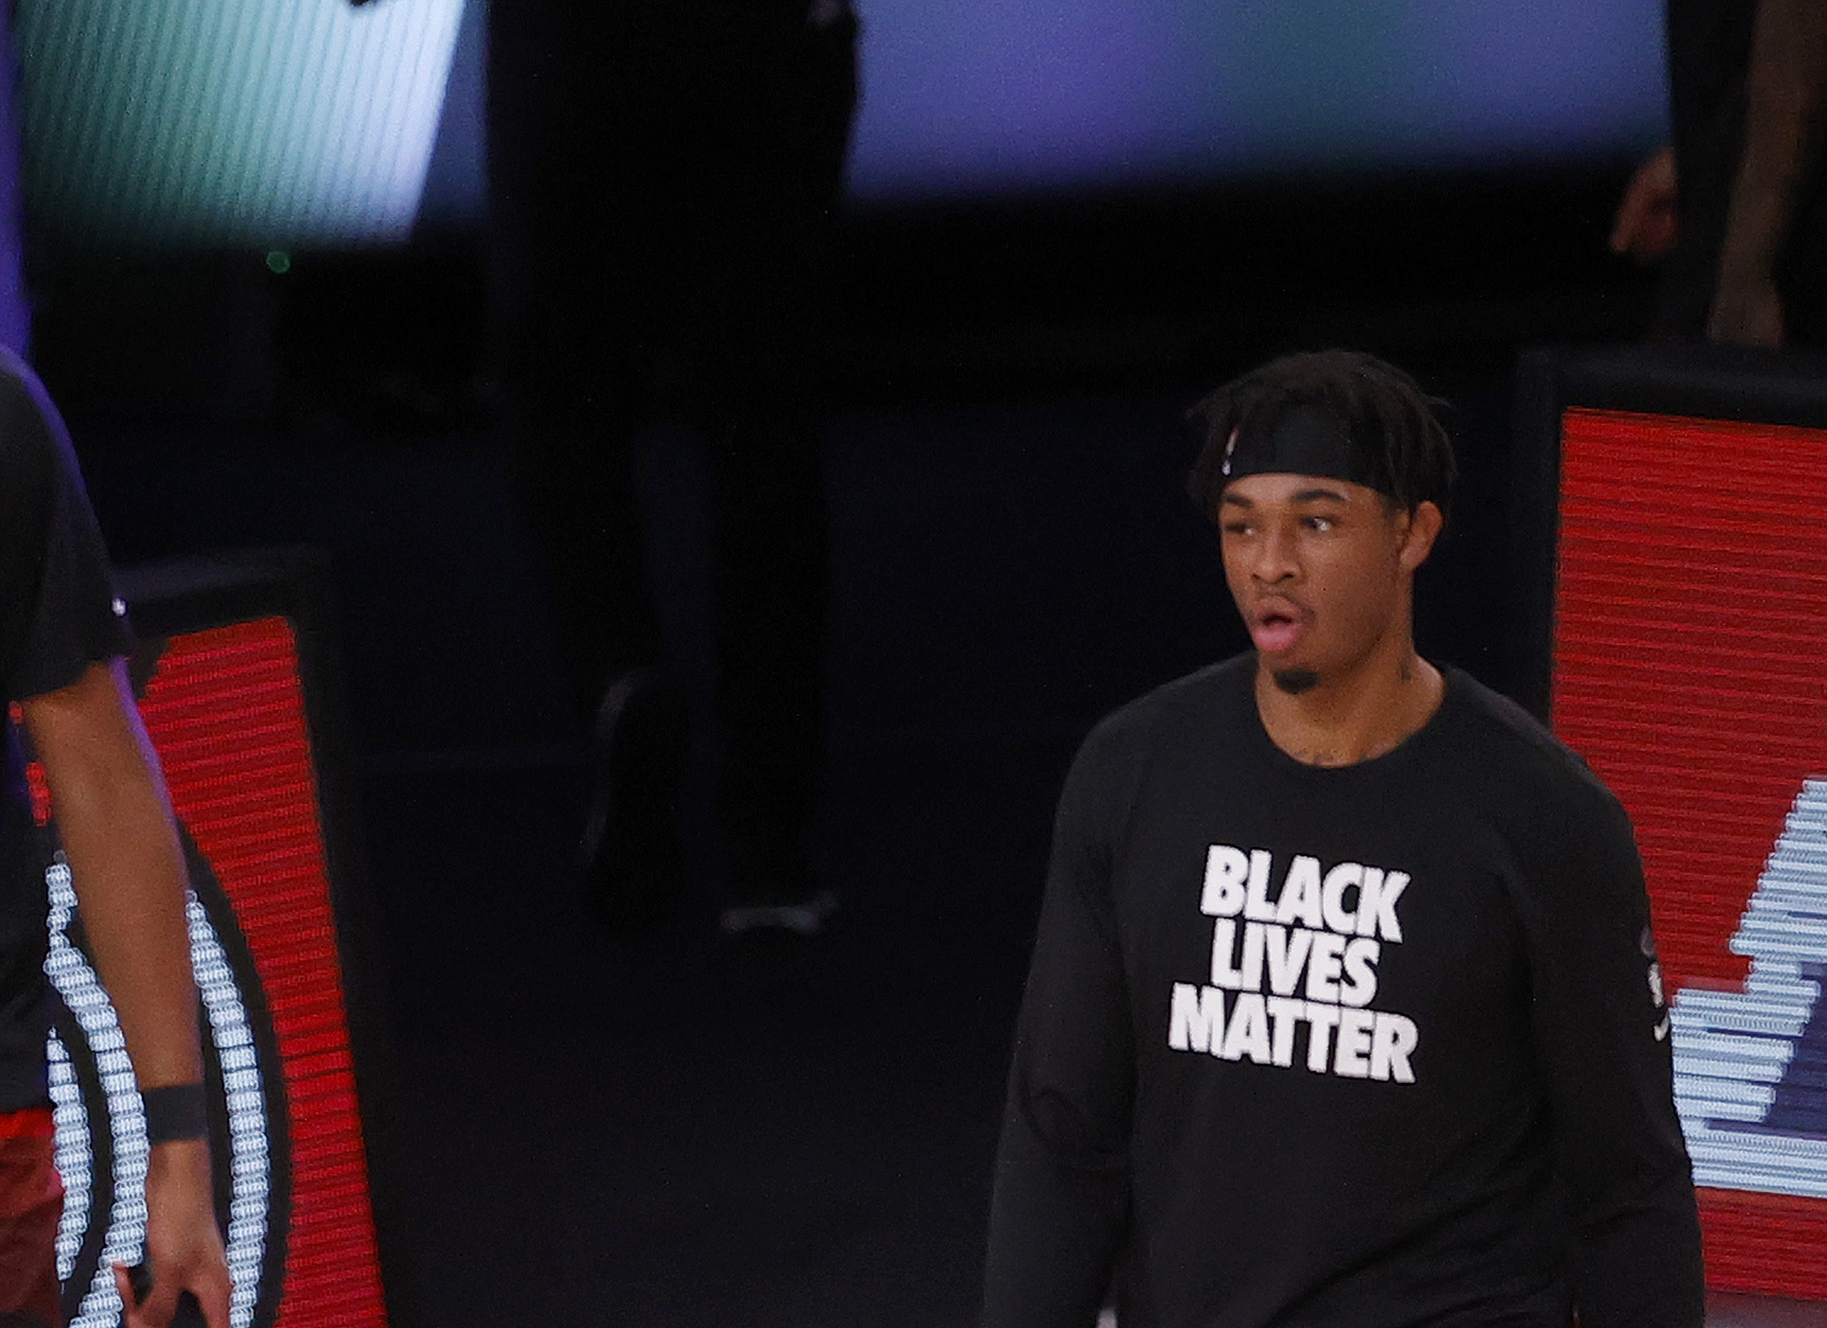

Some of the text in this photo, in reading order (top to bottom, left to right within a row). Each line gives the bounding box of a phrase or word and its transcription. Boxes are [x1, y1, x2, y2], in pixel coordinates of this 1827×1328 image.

[1199, 844, 1411, 944] BLACK
[1211, 918, 1381, 1008] LIVES
[1168, 983, 1419, 1084] MATTER
